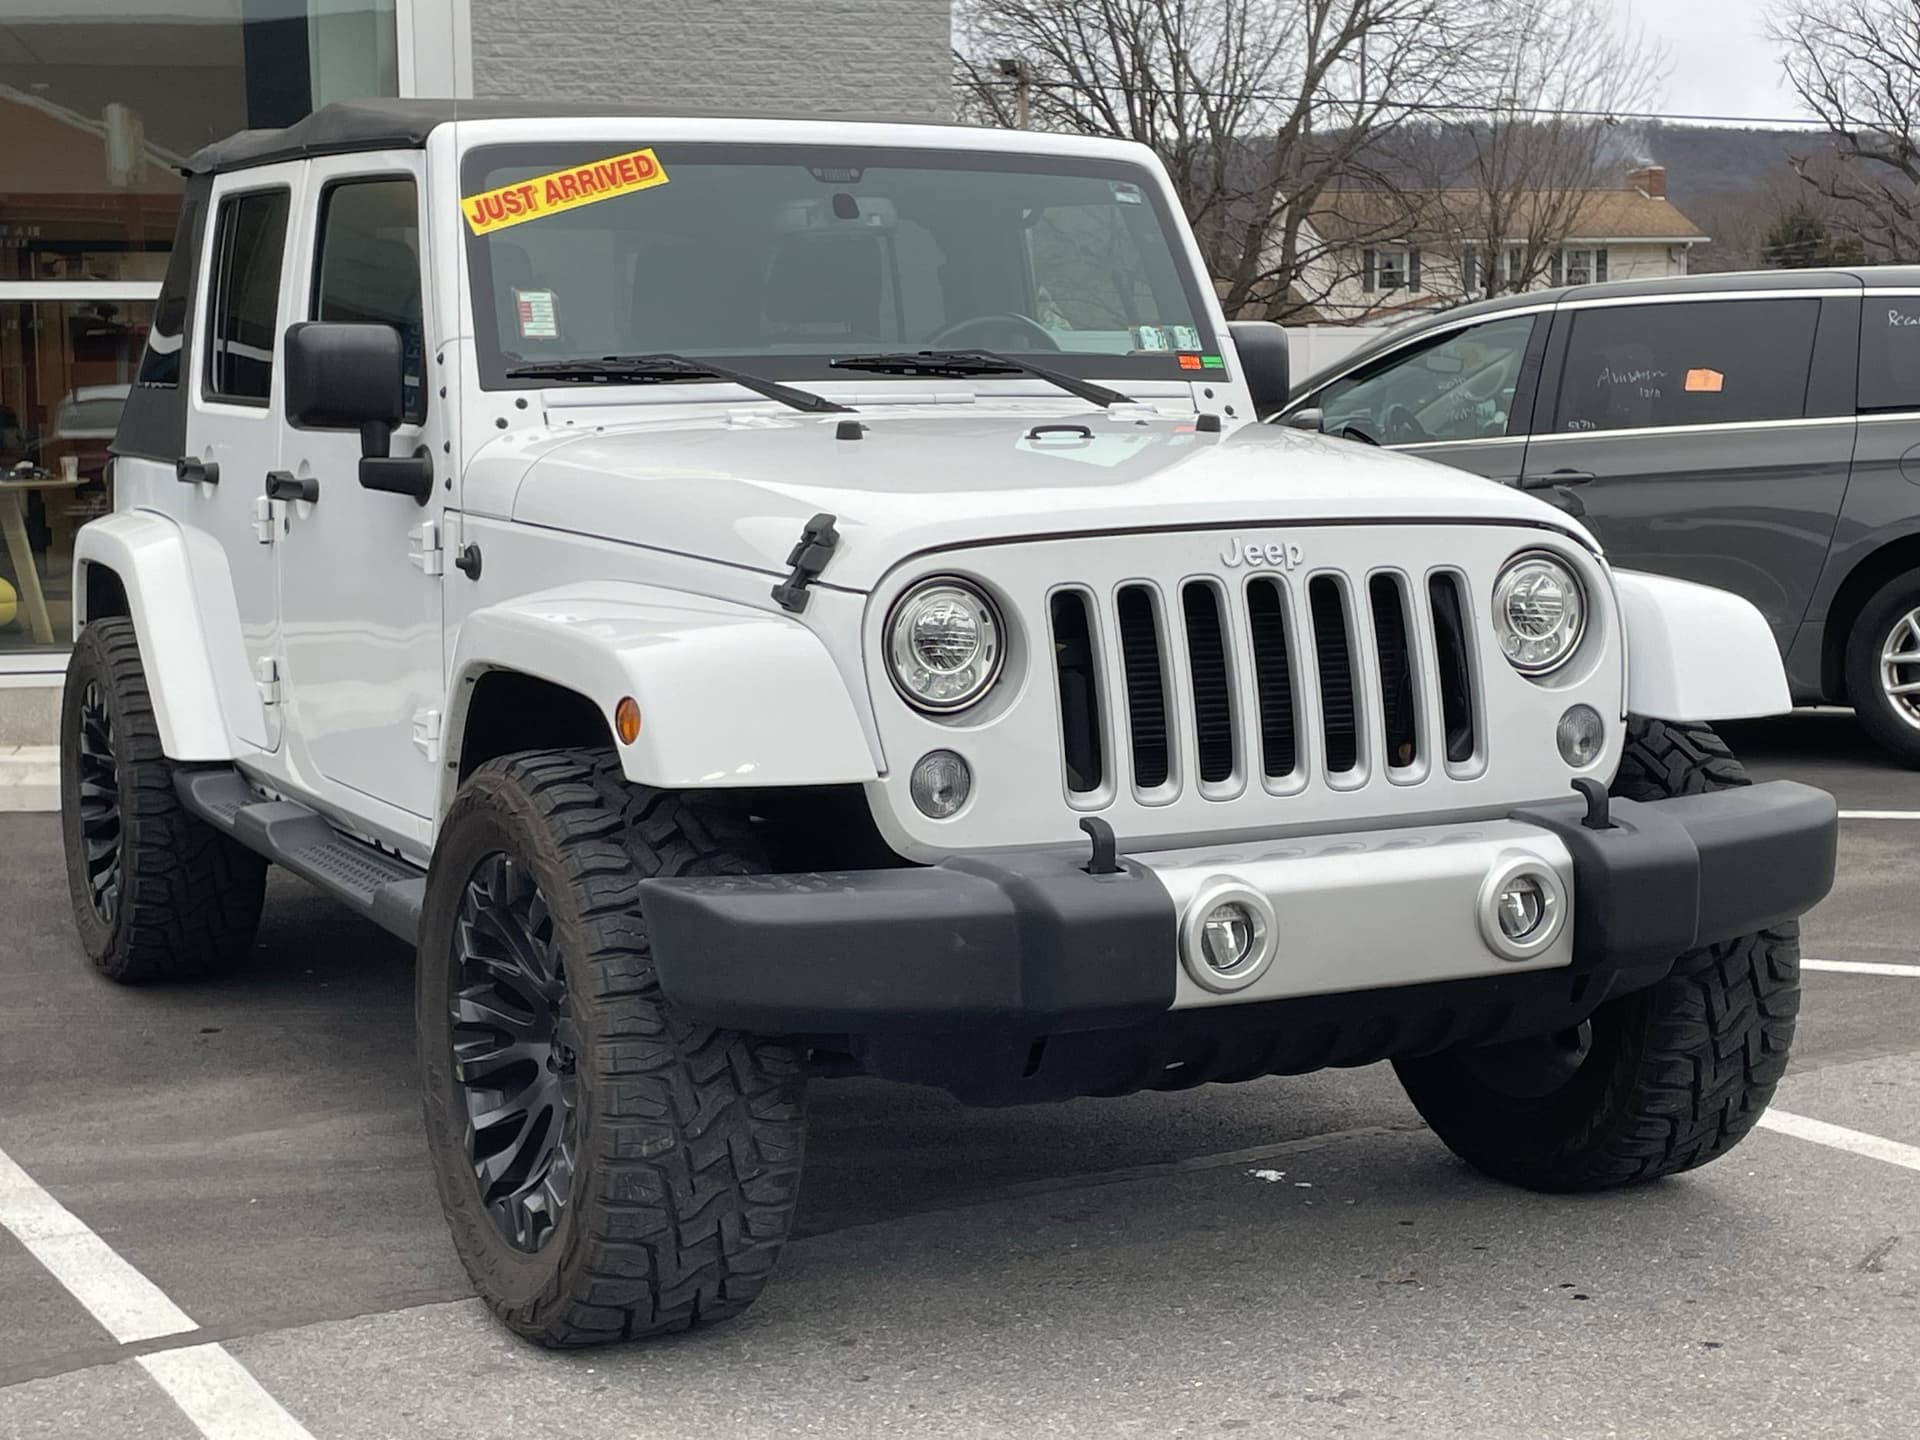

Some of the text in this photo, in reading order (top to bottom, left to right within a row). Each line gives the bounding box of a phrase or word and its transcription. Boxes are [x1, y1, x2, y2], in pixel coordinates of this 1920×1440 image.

[471, 154, 658, 226] JUST ARRIVED
[1219, 537, 1304, 571] Jeep
